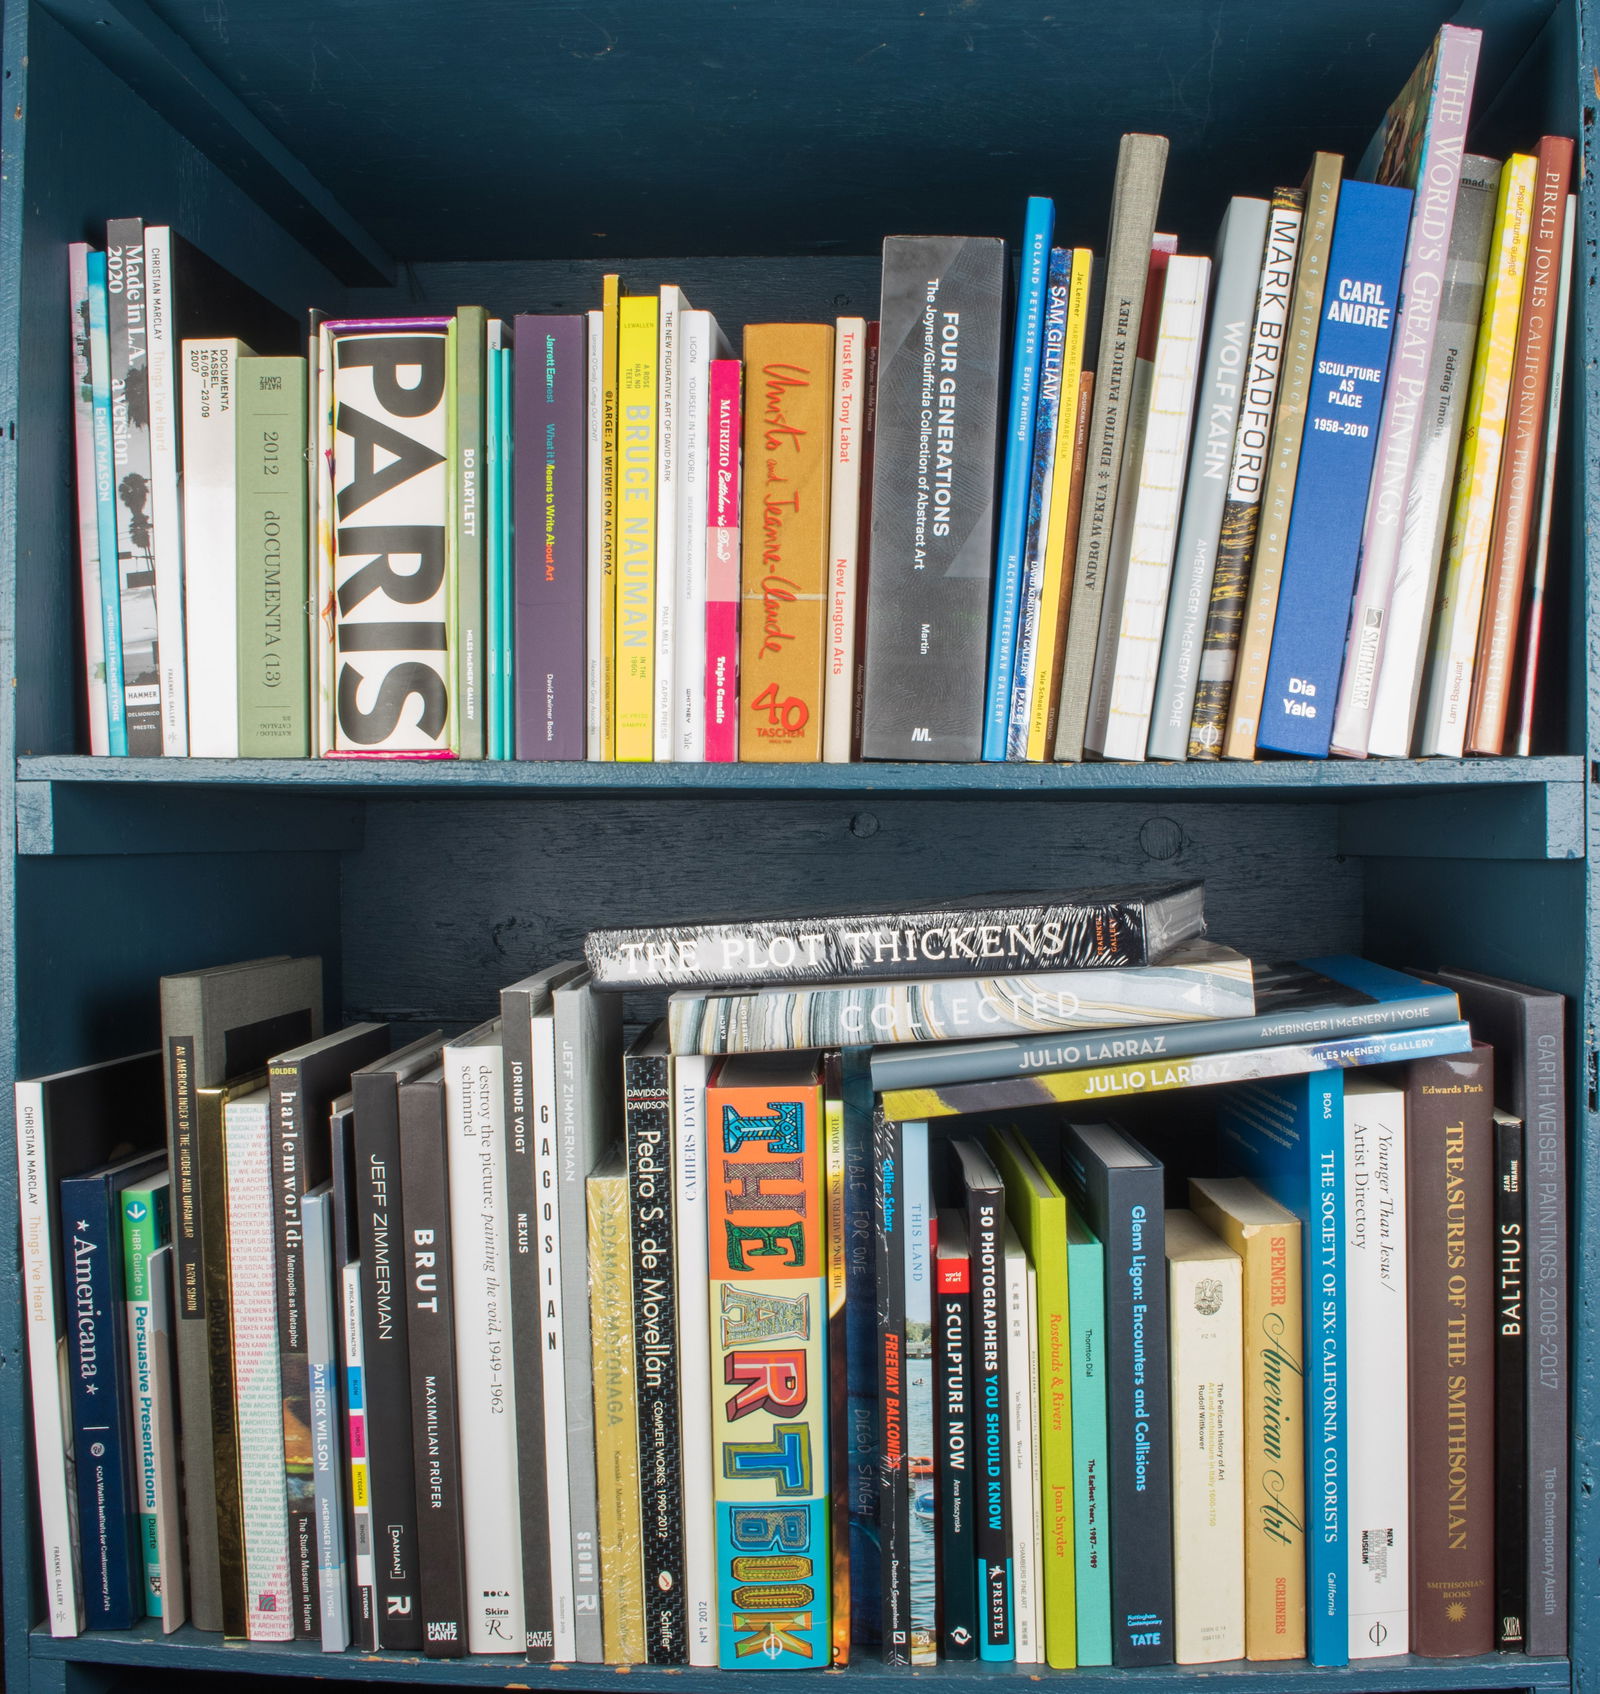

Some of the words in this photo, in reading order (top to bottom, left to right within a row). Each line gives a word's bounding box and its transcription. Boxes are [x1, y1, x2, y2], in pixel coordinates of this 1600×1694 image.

[1439, 70, 1470, 125] THE
[1418, 134, 1465, 261] WORLD'S
[1539, 172, 1560, 239] PIRKLE
[108, 246, 124, 295] 2020
[152, 248, 162, 296] CHRISTIAN
[1076, 272, 1085, 286] Jac
[1262, 220, 1297, 311] MARK
[1531, 246, 1552, 308] JONES
[1048, 285, 1066, 323] SAM
[1073, 288, 1083, 317] Leirner
[1338, 278, 1385, 306] CARL
[153, 298, 163, 342] MARCLAY
[664, 311, 673, 327] THE
[1117, 299, 1132, 337] FREY
[1326, 300, 1391, 329] ANDRE
[1401, 272, 1441, 368] GREAT
[545, 334, 556, 367] Jarrett
[664, 329, 672, 348] NEW
[842, 333, 854, 364] Trust
[940, 312, 959, 371] FOUR
[1215, 321, 1245, 400] WOLF
[191, 349, 200, 373] 2007
[211, 349, 219, 389] KASSEL
[219, 349, 229, 413] DOCUMENTA
[664, 351, 672, 399] FIGURATIVE
[842, 368, 853, 391] Me.
[1042, 330, 1063, 400] GILLIAM
[1108, 342, 1127, 401] PATRICK
[1318, 361, 1381, 383] SCULPTURE
[1516, 315, 1544, 440] CALIFORNIA
[545, 368, 556, 404] Earnest
[1237, 321, 1283, 492] BRADFORD
[1328, 391, 1362, 409] PLACE
[95, 408, 108, 451] EMILY
[603, 391, 613, 438] @LARGE:
[664, 401, 672, 417] ART
[664, 420, 672, 430] OF
[839, 394, 852, 423] Tony
[262, 431, 279, 476] 2012
[464, 449, 476, 468] BO
[604, 441, 613, 452] AI
[625, 404, 650, 506] BRUCE
[663, 433, 672, 457] DAVID
[839, 427, 851, 463] Labat
[932, 378, 956, 537] GENERATIONS
[1100, 406, 1119, 467] EDITION
[1203, 403, 1234, 480] KAHN
[1376, 374, 1426, 526] PAINTINGS
[96, 453, 110, 502] MASON
[603, 456, 613, 498] WEIWEI
[663, 459, 671, 482] PARK
[464, 470, 477, 537] BARTLETT
[603, 500, 613, 517] ON
[1091, 484, 1108, 537] WEKUA
[1498, 449, 1530, 600] PHOTOGRAPHS
[337, 336, 449, 745] PARIS
[603, 520, 613, 576] ALCATRAZ
[263, 510, 282, 647] dOCUMENTA
[624, 517, 650, 648] NAUMAN
[835, 558, 847, 587] New
[1084, 541, 1102, 592] ANDRO
[832, 591, 846, 643] Langton
[920, 624, 931, 654] Martin
[262, 653, 282, 689] (13)
[546, 673, 555, 693] David
[833, 647, 843, 675] Arts
[546, 695, 555, 720] Zwirner
[1282, 698, 1317, 719] Yale
[546, 721, 555, 742] Books
[619, 941, 700, 974] THE
[720, 933, 826, 969] PLOT
[845, 922, 1064, 964] THICKENS
[840, 991, 1079, 1033] COLLECTED
[562, 1041, 573, 1079] JEFF
[1018, 1046, 1080, 1069] JULIO
[1086, 1035, 1167, 1061] LARRAZ
[461, 1065, 477, 1138] schimmel
[511, 1061, 524, 1113] JORINDE
[627, 1089, 669, 1097] DAVIDSON
[627, 1102, 669, 1111] DAVIDSON
[1322, 1092, 1332, 1120] BOAS
[1421, 1084, 1461, 1095] Edwards
[1462, 1084, 1484, 1093] Park
[24, 1106, 35, 1156] CHRISTIAN
[513, 1116, 525, 1154] VOIGT
[563, 1083, 575, 1182] ZIMMERMAN
[1353, 1123, 1368, 1167] Artist
[27, 1160, 38, 1205] MARCLAY
[370, 1154, 387, 1207] JEFF
[721, 1102, 807, 1272] THE
[1320, 1150, 1336, 1188] THE
[980, 1206, 994, 1227] 50
[1350, 1173, 1369, 1250] Directory
[1445, 1120, 1465, 1269] TREASURES
[130, 1229, 143, 1250] HBR
[517, 1213, 529, 1254] NEXUS
[911, 1204, 922, 1238] THIS
[1131, 1206, 1146, 1251] Glenn
[1321, 1191, 1336, 1269] SOCIETY
[132, 1252, 144, 1283] Guide
[286, 1254, 297, 1296] Metropolis
[372, 1212, 393, 1340] ZIMMERMAN
[414, 1228, 438, 1313] BRUT
[912, 1243, 923, 1282] LAND
[1128, 1255, 1146, 1301] Ligon:
[1270, 1237, 1286, 1307] SPENCER
[1501, 1224, 1520, 1336] BALTHUS
[73, 1235, 102, 1379] Americana
[134, 1285, 144, 1296] to
[288, 1298, 295, 1307] as
[981, 1232, 998, 1371] PHOTOGRAPHERS
[1322, 1273, 1337, 1297] OF
[1447, 1275, 1467, 1308] OF
[287, 1309, 299, 1348] Metaphor
[1322, 1301, 1337, 1334] SIX:
[135, 1306, 151, 1392] Persuasive
[946, 1303, 963, 1413] SCULPTURE
[1132, 1304, 1148, 1385] Encounters
[1447, 1313, 1467, 1368] THE
[312, 1363, 327, 1416] PATRICK
[719, 1284, 815, 1498] ART
[985, 1375, 999, 1409] YOU
[1133, 1388, 1150, 1418] and
[1198, 1384, 1206, 1411] Rudolf
[1323, 1338, 1338, 1443] CALIFORNIA
[425, 1376, 439, 1456] MAXIMILIAN
[653, 1400, 664, 1447] COMPLETE
[1198, 1412, 1206, 1450] Wittkower
[140, 1397, 157, 1508] Presentations
[316, 1420, 329, 1471] WILSON
[948, 1421, 965, 1470] NOW
[986, 1413, 1000, 1477] SHOULD
[1134, 1421, 1151, 1492] Collisions
[1448, 1374, 1467, 1550] SMITHSONIAN
[429, 1461, 442, 1509] PRÜFER
[655, 1449, 666, 1486] WORKS:
[988, 1481, 1002, 1530] KNOW
[1323, 1447, 1338, 1544] COLORISTS
[147, 1518, 159, 1550] Duarte
[298, 1518, 307, 1532] The
[300, 1533, 310, 1558] Studio
[301, 1560, 311, 1592] Museum
[729, 1504, 815, 1660] BOOK
[890, 1560, 900, 1589] Deutsche
[1327, 1572, 1337, 1616] California
[303, 1594, 311, 1602] in
[303, 1604, 313, 1631] Harlem
[890, 1590, 900, 1629] Guggenheim
[660, 1610, 673, 1650] Schiffer
